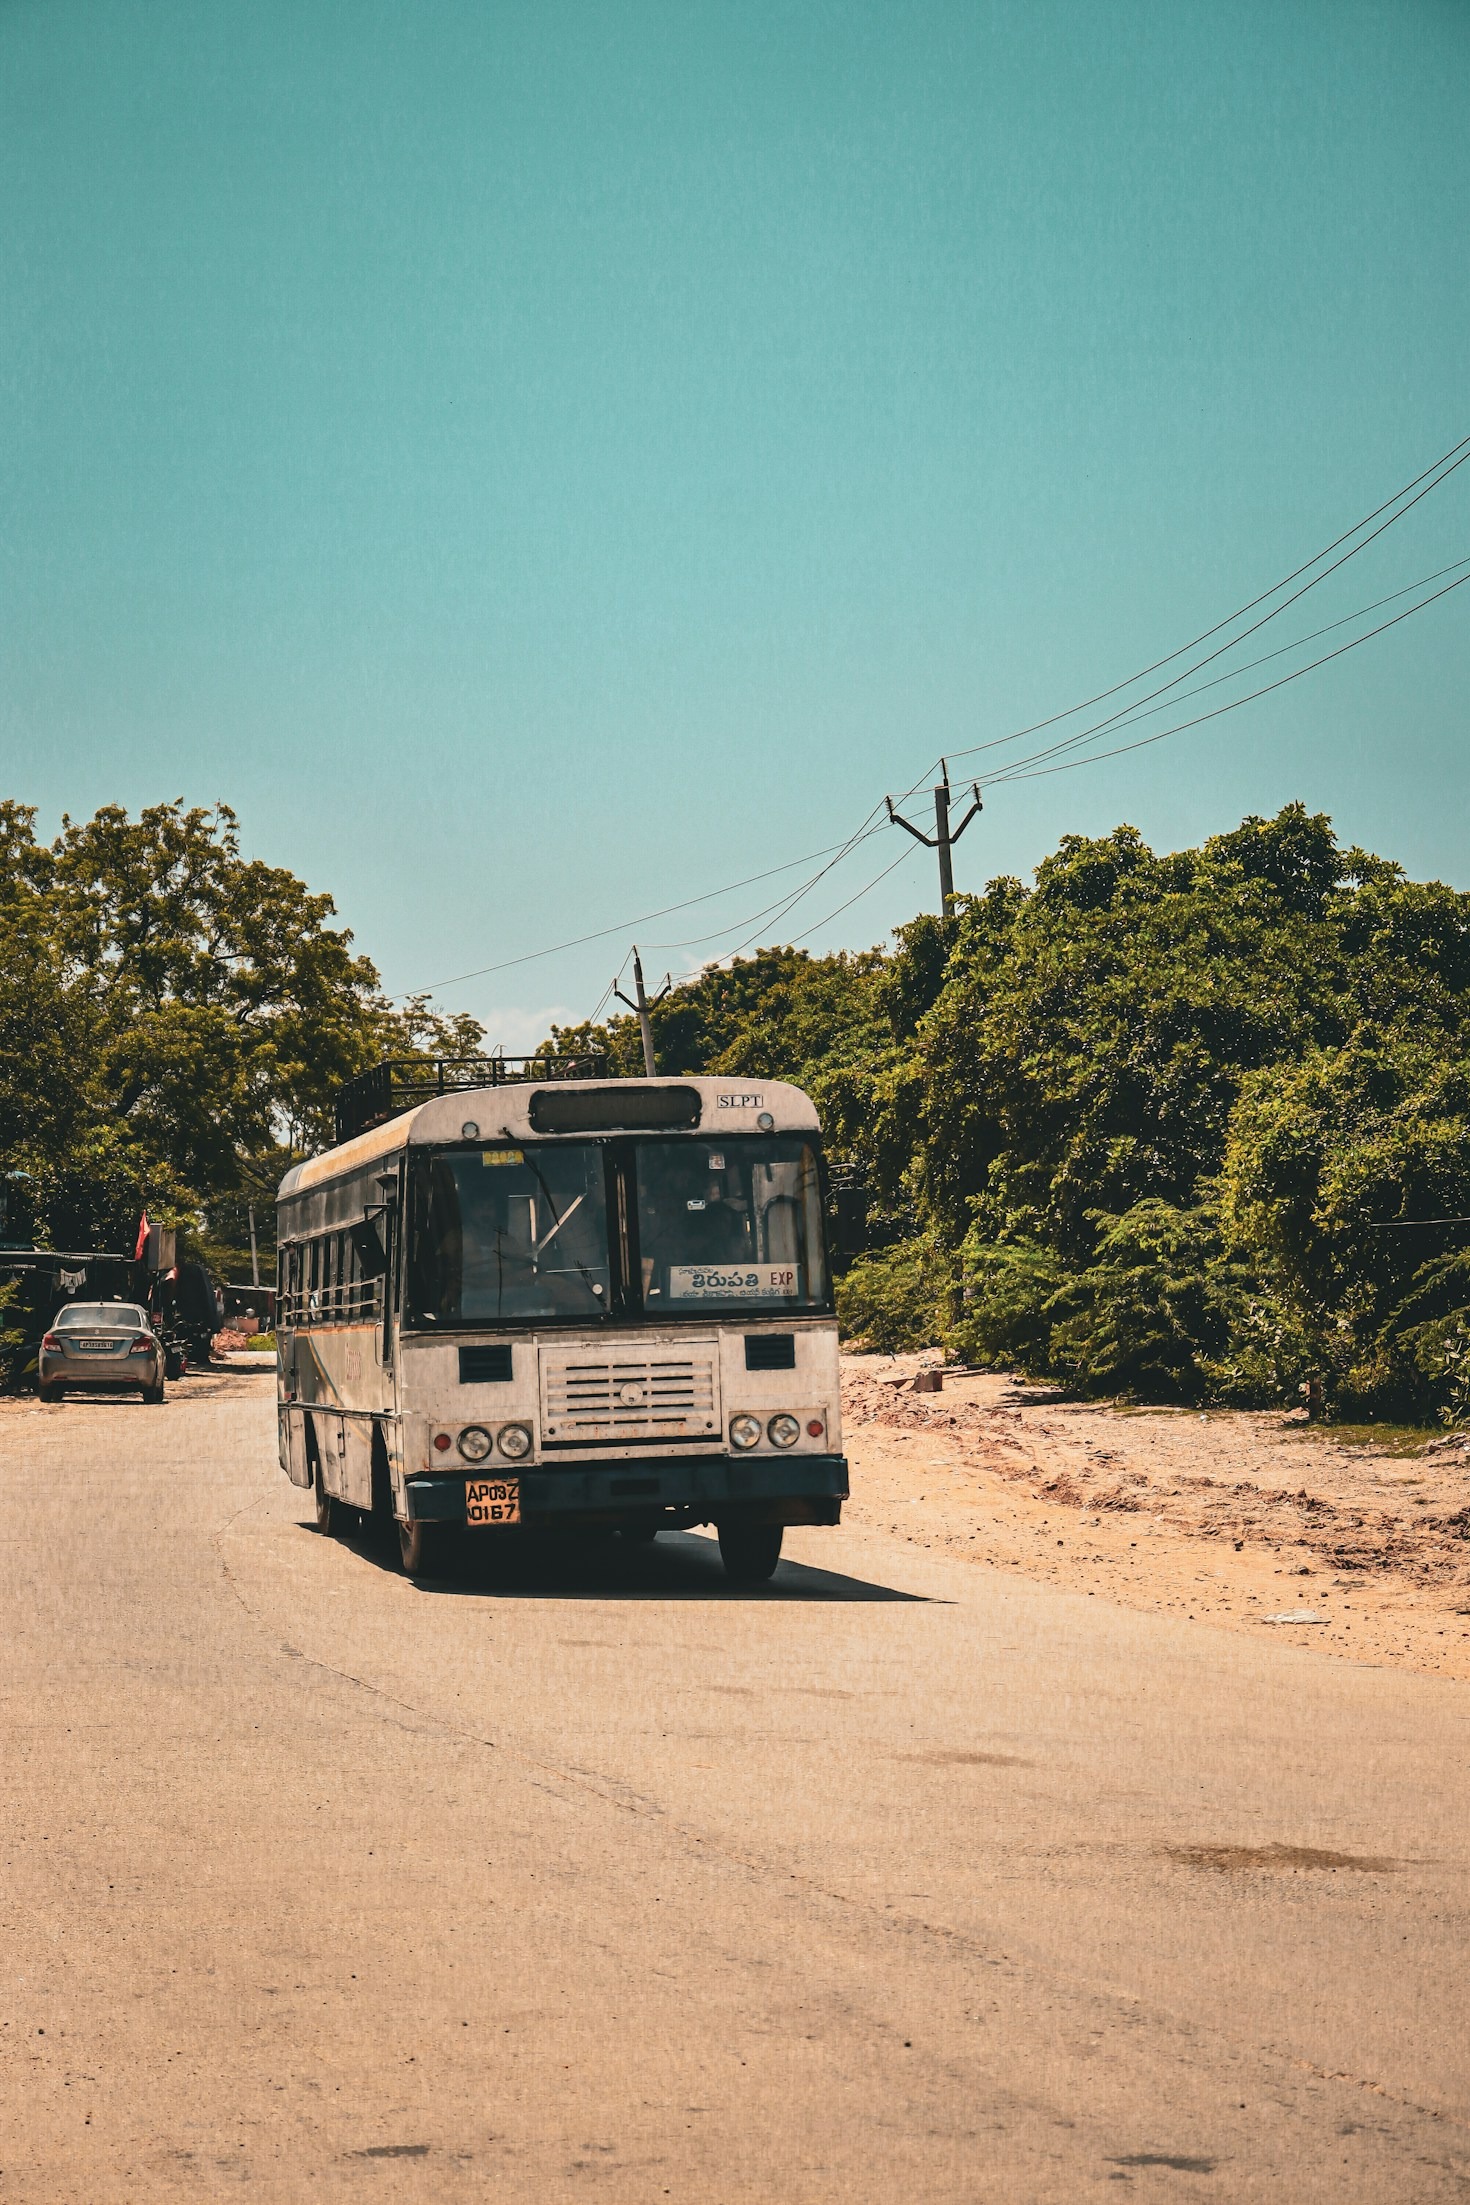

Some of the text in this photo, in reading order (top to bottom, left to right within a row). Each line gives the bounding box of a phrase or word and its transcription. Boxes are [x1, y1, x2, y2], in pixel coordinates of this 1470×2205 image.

[720, 1097, 761, 1107] SLPT
[691, 1271, 794, 1288] తిరుపతి EXP
[467, 1483, 519, 1503] AP03Z
[468, 1503, 516, 1521] 0167
